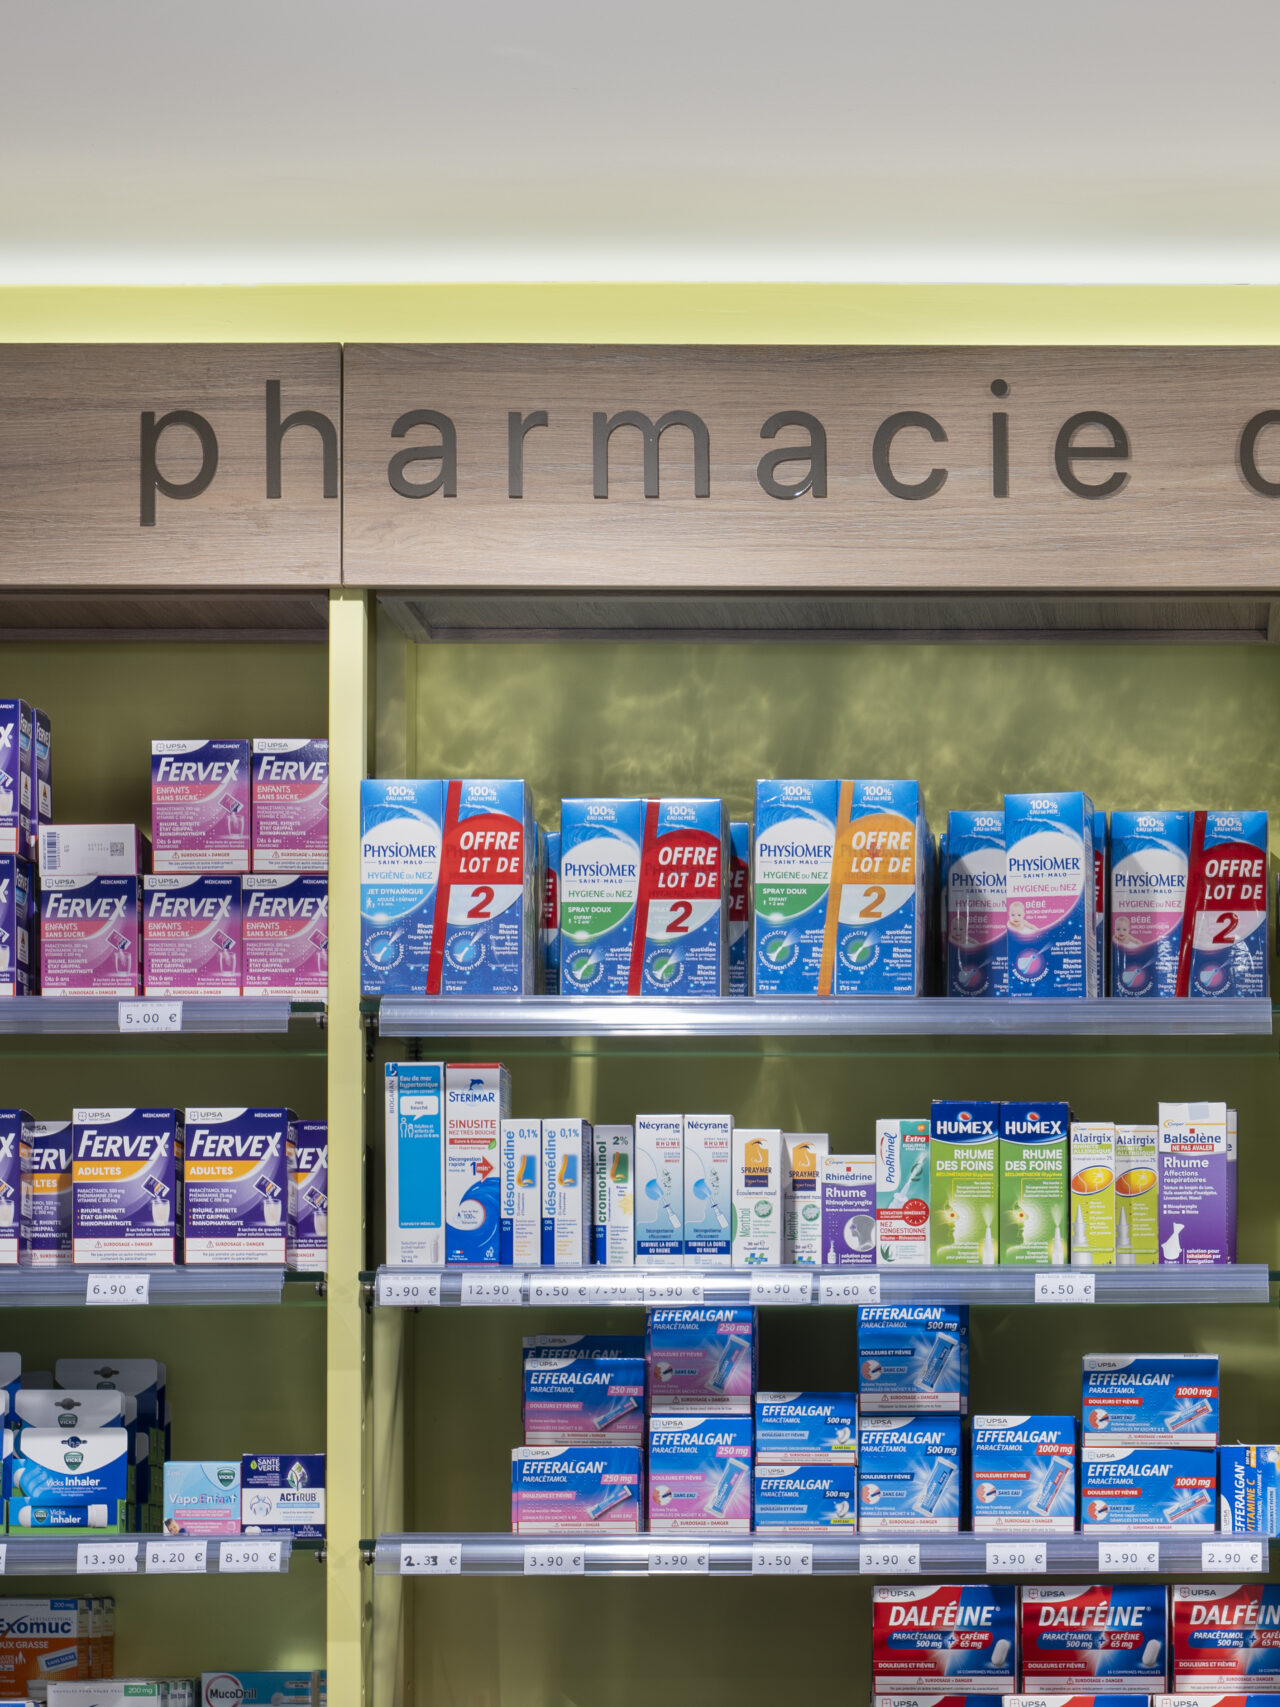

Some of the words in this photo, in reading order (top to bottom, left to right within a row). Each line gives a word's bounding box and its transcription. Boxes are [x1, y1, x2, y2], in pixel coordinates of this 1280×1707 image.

[138, 378, 1132, 527] pharmacie
[156, 757, 240, 783] FERVEX
[156, 786, 190, 795] ENFANTS
[460, 831, 520, 851] OFFRE
[851, 831, 912, 850] OFFRE
[658, 846, 717, 866] OFFRE
[459, 857, 491, 873] LOT
[495, 857, 519, 873] DE
[851, 857, 882, 873] LOT
[889, 857, 912, 873] DE
[658, 872, 689, 888] LOT
[693, 872, 716, 888] DE
[45, 893, 127, 919] FERVEX
[467, 886, 495, 919] 2
[859, 886, 887, 918] 2
[1025, 899, 1046, 909] BÉBÉ
[665, 901, 693, 934] 2
[125, 1012, 159, 1023] 5.00
[169, 1012, 177, 1023] €
[449, 1119, 497, 1129] SINUSITE
[639, 1121, 680, 1132] Nécyrane
[687, 1121, 729, 1132] Nécyrane
[936, 1120, 993, 1135] HUMEX
[1005, 1119, 1062, 1135] HUMEX
[518, 1128, 538, 1139] 0,1%
[905, 1135, 926, 1143] Extra
[1073, 1133, 1112, 1145] Alairgix
[1163, 1132, 1222, 1144] Balsolène
[77, 1129, 170, 1158] FERVEX
[189, 1129, 282, 1158] FERVEX
[954, 1149, 994, 1160] RHUME
[936, 1161, 956, 1171] DES
[958, 1161, 994, 1171] FOINS
[1163, 1156, 1210, 1168] Rhume
[77, 1166, 121, 1176] ADULTES
[189, 1166, 233, 1176] ADULTES
[504, 1130, 515, 1217] désomédine
[545, 1130, 556, 1217] désomédine
[741, 1166, 772, 1175] SPRAYMER
[825, 1172, 873, 1181] Rhinédrine
[596, 1140, 607, 1224] cromorhinol
[825, 1187, 867, 1198] Rhume
[385, 1286, 419, 1297] 3.90
[429, 1286, 437, 1297] €
[535, 1286, 569, 1297] 6.50
[578, 1286, 587, 1297] €
[649, 1286, 683, 1297] 5.90
[692, 1286, 700, 1296] €
[757, 1284, 790, 1294] 6.90
[800, 1285, 808, 1295] €
[826, 1286, 859, 1297] 5.60
[869, 1285, 877, 1295] €
[861, 1307, 942, 1320] EFFERALGAN
[530, 1372, 611, 1385] EFFERALGAN
[1089, 1373, 1171, 1386] EFFERALGAN
[652, 1432, 733, 1445] EFFERALGAN
[976, 1430, 1057, 1444] EFFERALGAN
[65, 1476, 100, 1487] Inhaler
[151, 1552, 185, 1563] 8.20
[194, 1552, 203, 1562] €
[225, 1552, 259, 1563] 8.90
[268, 1552, 277, 1562] €
[758, 1555, 791, 1566] 3.50
[801, 1555, 809, 1565] €
[865, 1555, 898, 1565] 3.90
[908, 1555, 916, 1565] €
[1207, 1553, 1241, 1564] 2.90
[1250, 1553, 1258, 1563] €
[889, 1601, 993, 1627] DALFÉINE
[210, 1688, 257, 1700] MucoDrill
